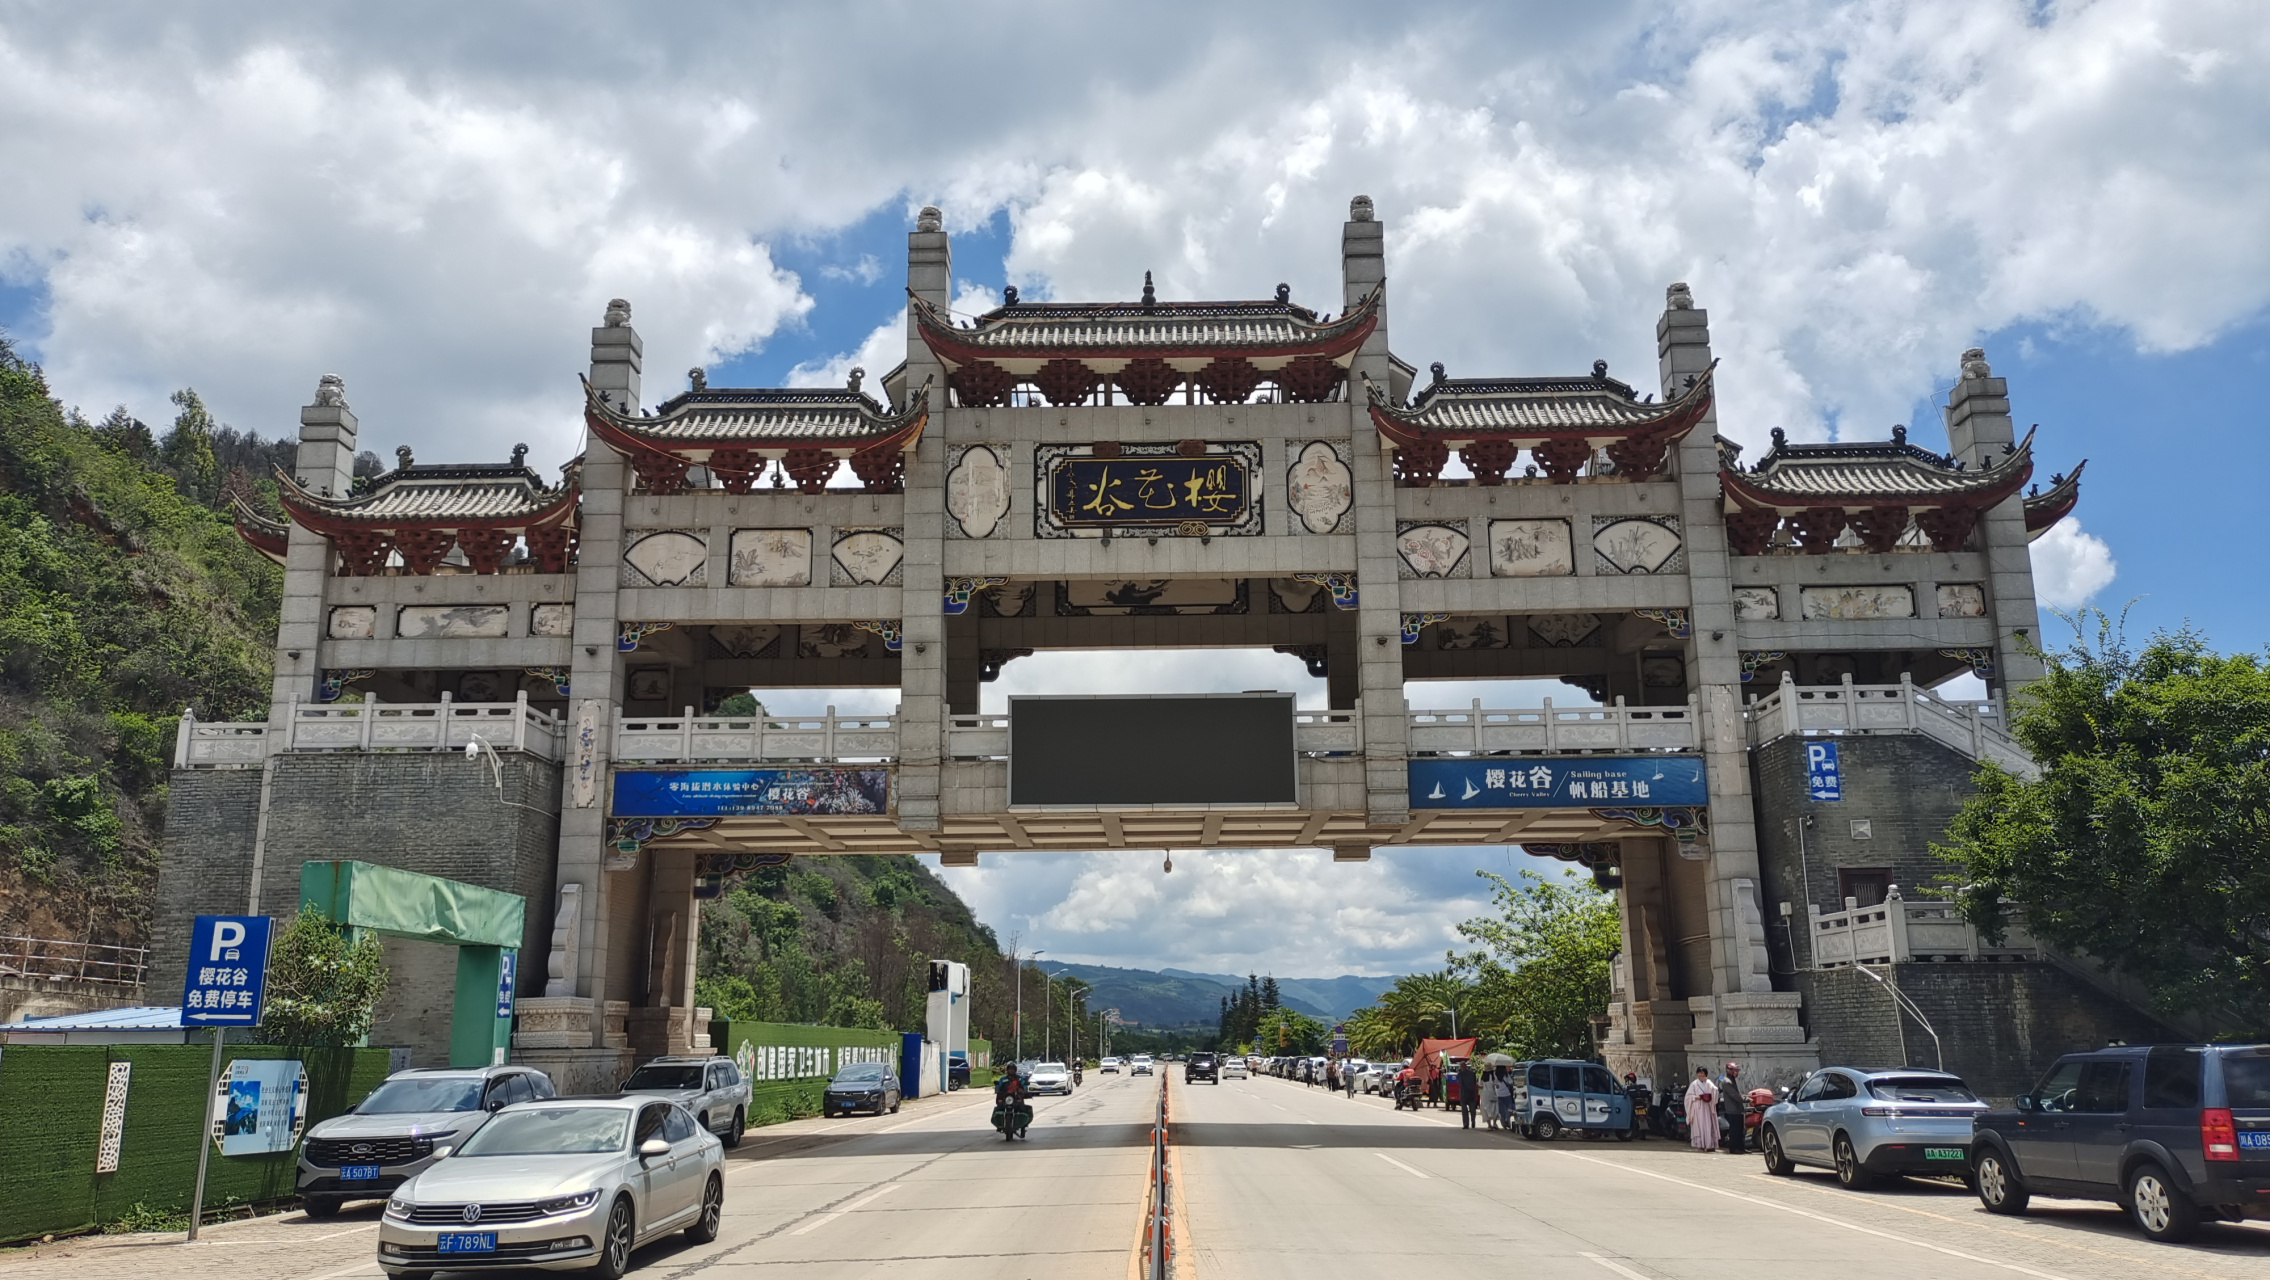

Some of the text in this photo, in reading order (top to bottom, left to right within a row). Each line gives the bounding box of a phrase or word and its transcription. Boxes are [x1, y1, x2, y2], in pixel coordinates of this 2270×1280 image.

[1808, 745, 1826, 771] P
[1485, 765, 1552, 790] 樱花谷
[1571, 770, 1627, 779] Sailing base
[1811, 775, 1837, 788] 免费
[669, 782, 759, 792] 零海拔潜水体验中心
[767, 787, 811, 801] 樱花谷
[1569, 780, 1650, 799] 帆船基地
[209, 921, 246, 961] P
[198, 966, 248, 986] 樱花谷
[500, 956, 510, 985] P
[187, 989, 254, 1009] 免费停车
[498, 990, 511, 1004] 免费
[757, 1045, 830, 1081] 创建国家卫生城市
